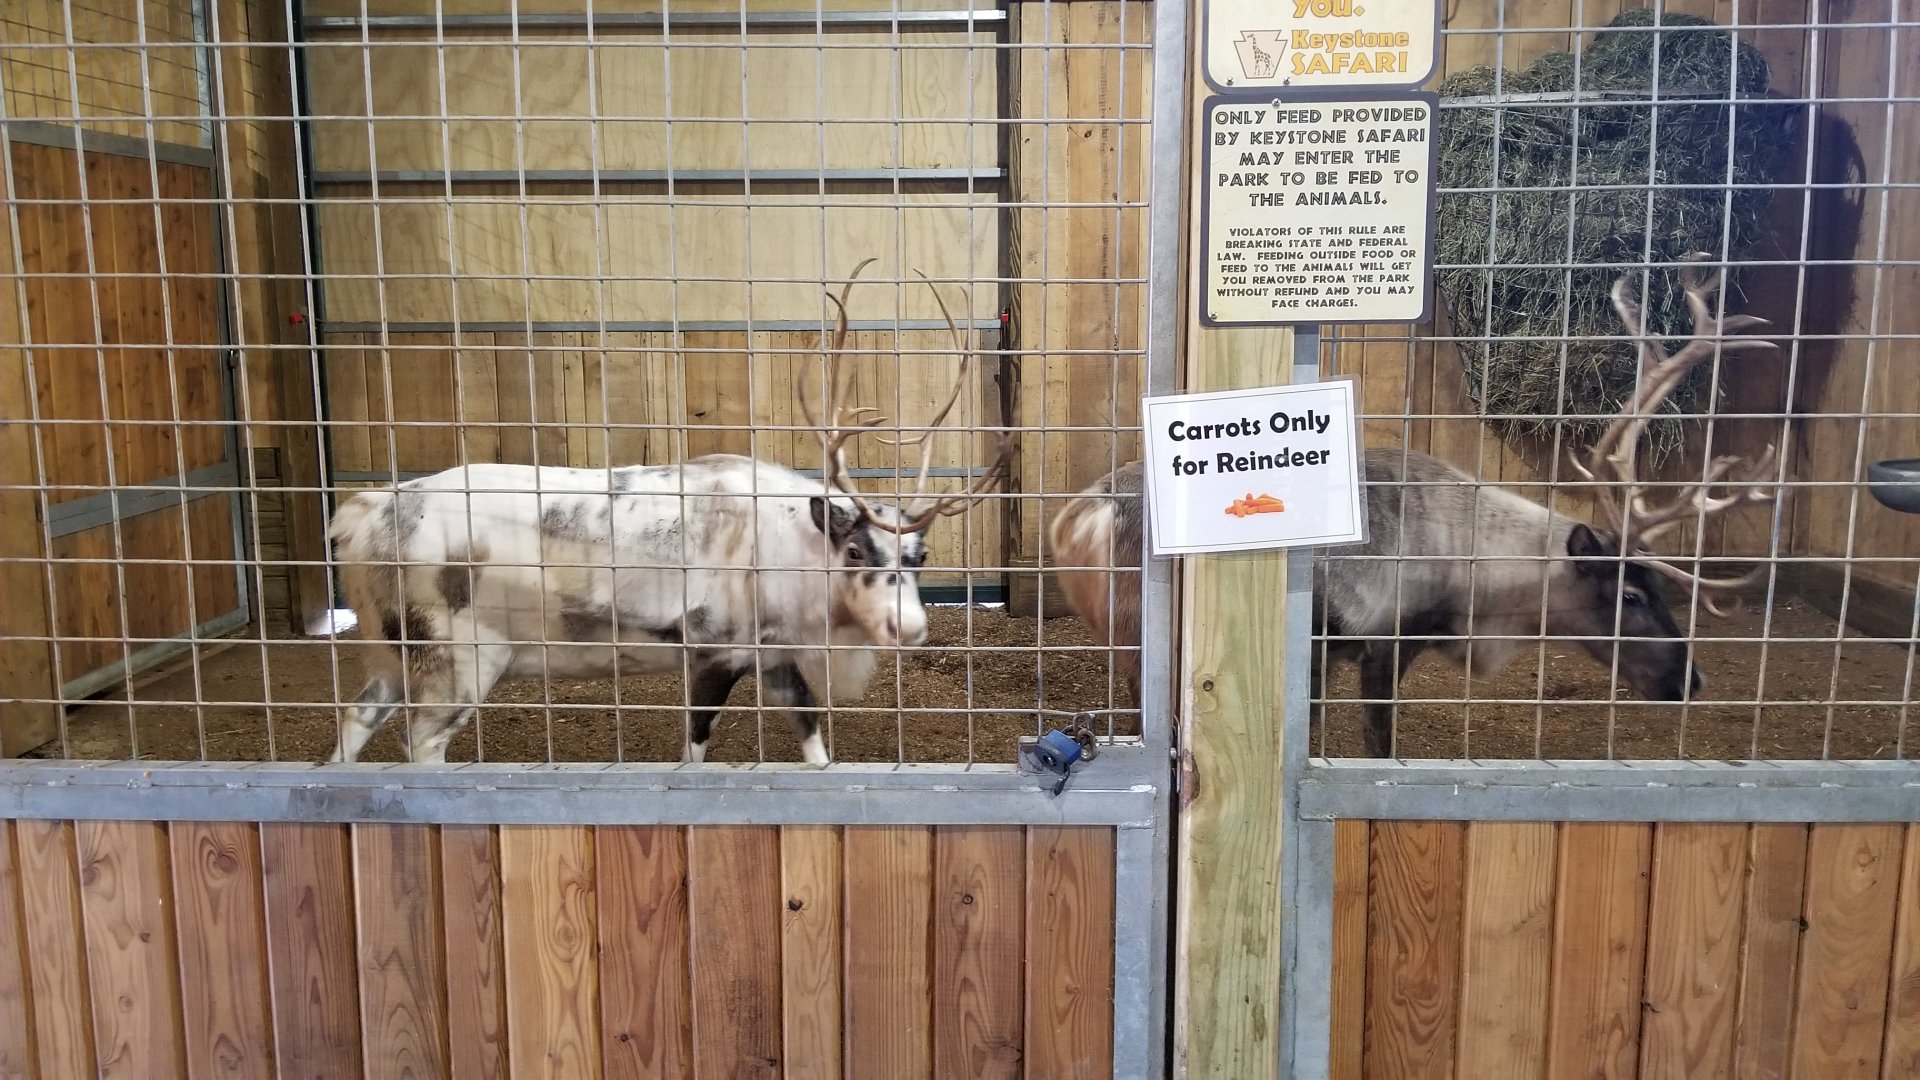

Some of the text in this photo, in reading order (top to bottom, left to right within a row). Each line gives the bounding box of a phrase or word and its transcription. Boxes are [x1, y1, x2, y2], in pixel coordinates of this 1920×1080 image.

[1291, 29, 1409, 53] Keystone
[1291, 52, 1407, 75] SAFARI
[1215, 108, 1427, 125] ONLY FEED PROVIDED
[1215, 129, 1425, 145] BY KEYSTONE SAFARI
[1239, 150, 1400, 166] MAY ENTER THE
[1219, 170, 1418, 186] PARK TO BE FED TO
[1249, 191, 1388, 207] THE ANIMALS.
[1230, 226, 1406, 237] VIOLATORS OF THIS RULE ARE
[1226, 238, 1408, 249] BREAKING STATE AND FEDERAL
[1217, 250, 1416, 261] LAW. FEEDING OUTSIDE FOOD OR
[1221, 262, 1412, 273] FEED TO THE ANIMALS WILL GET
[1222, 274, 1410, 285] YOU REMOVED FROM THE PARK
[1217, 286, 1415, 297] WITHOUT REFUND AND YOU MAY
[1272, 299, 1358, 308] FACE CHARGES.
[1168, 409, 1330, 441] Carrots Only
[1173, 447, 1330, 476] for Reindeer
